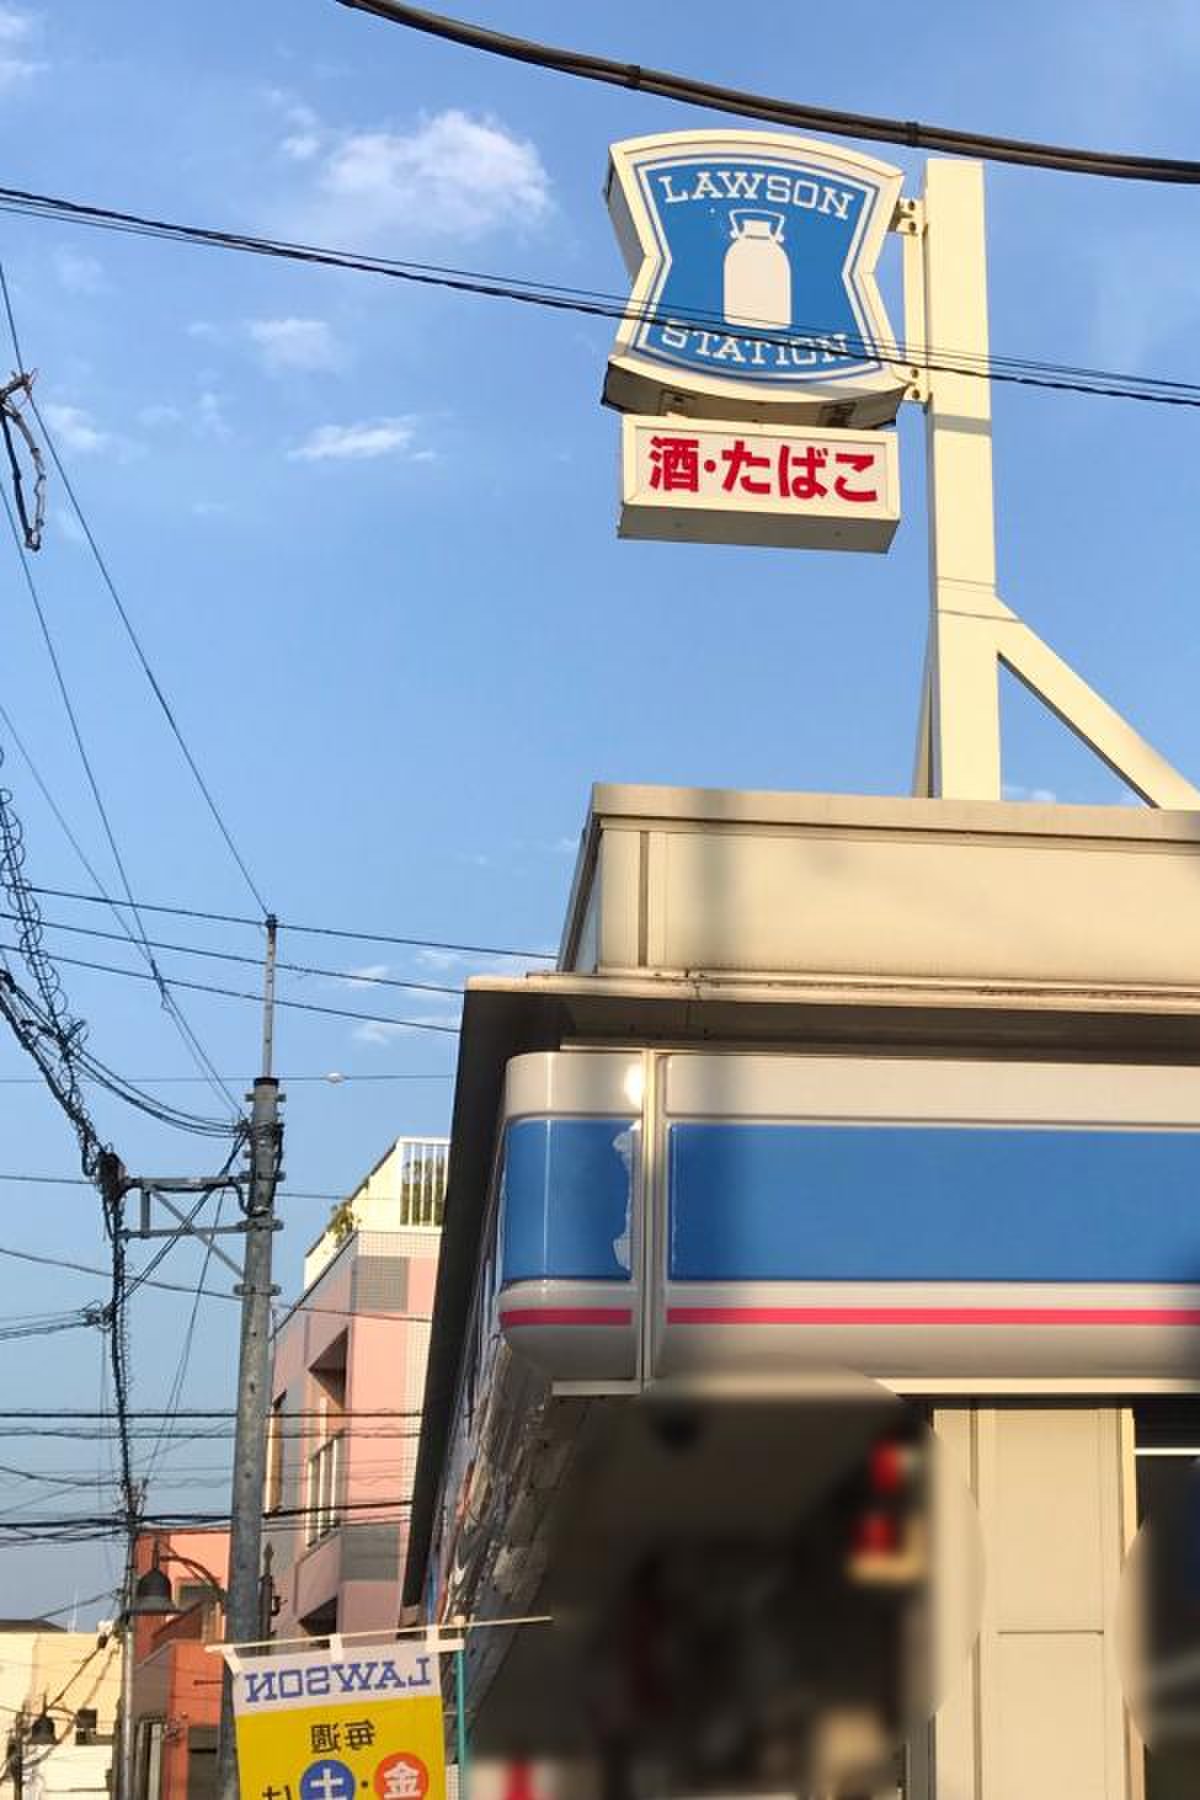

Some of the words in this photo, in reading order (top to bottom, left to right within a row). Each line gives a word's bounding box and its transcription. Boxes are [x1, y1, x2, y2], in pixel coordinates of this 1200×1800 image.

[658, 171, 855, 220] LAWSON
[649, 435, 878, 503] 酒・たばこ
